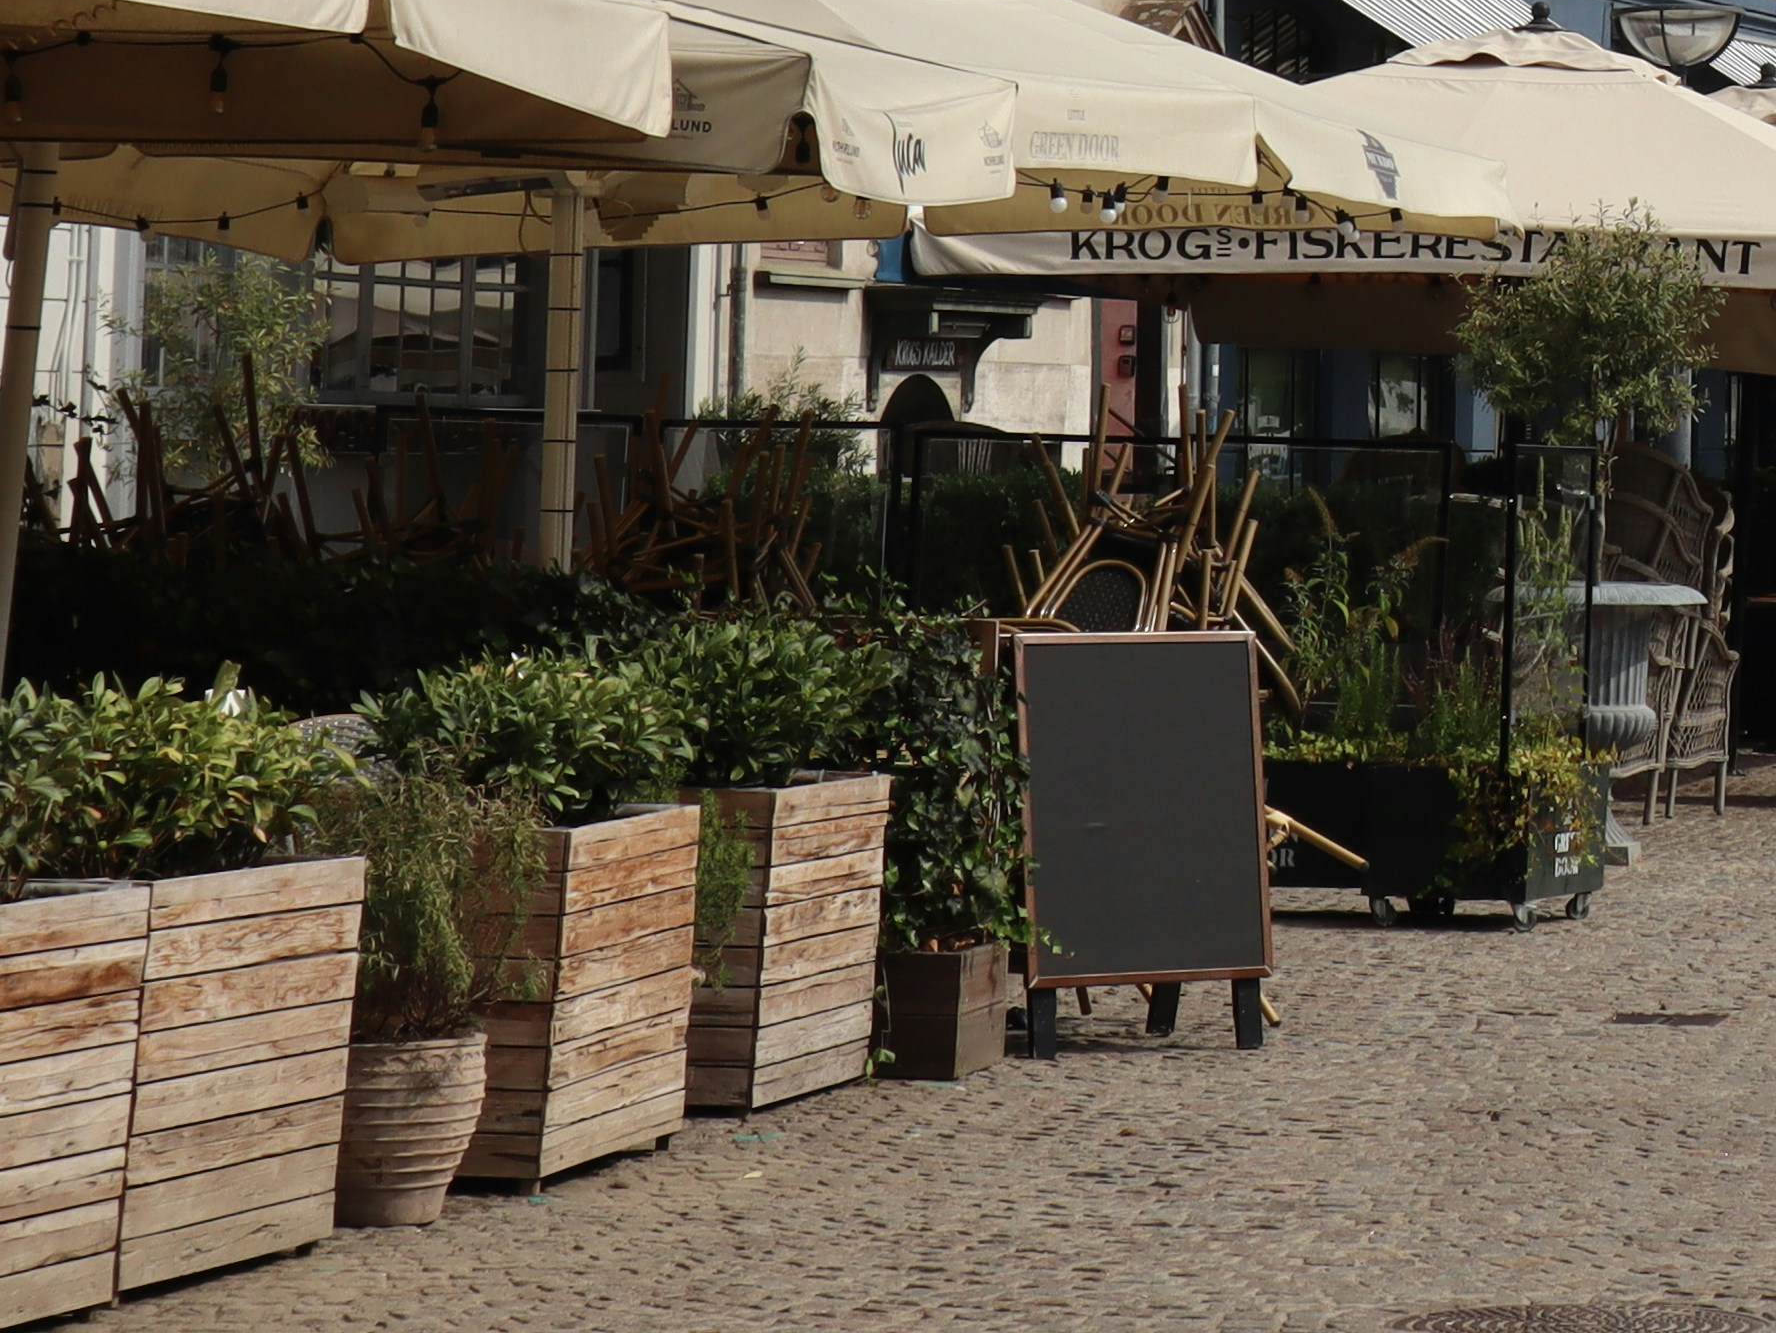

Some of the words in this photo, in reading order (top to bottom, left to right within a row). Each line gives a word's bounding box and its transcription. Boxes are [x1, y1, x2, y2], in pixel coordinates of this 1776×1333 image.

[672, 119, 713, 133] LUND
[1029, 131, 1074, 161] GREEN
[1077, 132, 1120, 163] DOOR
